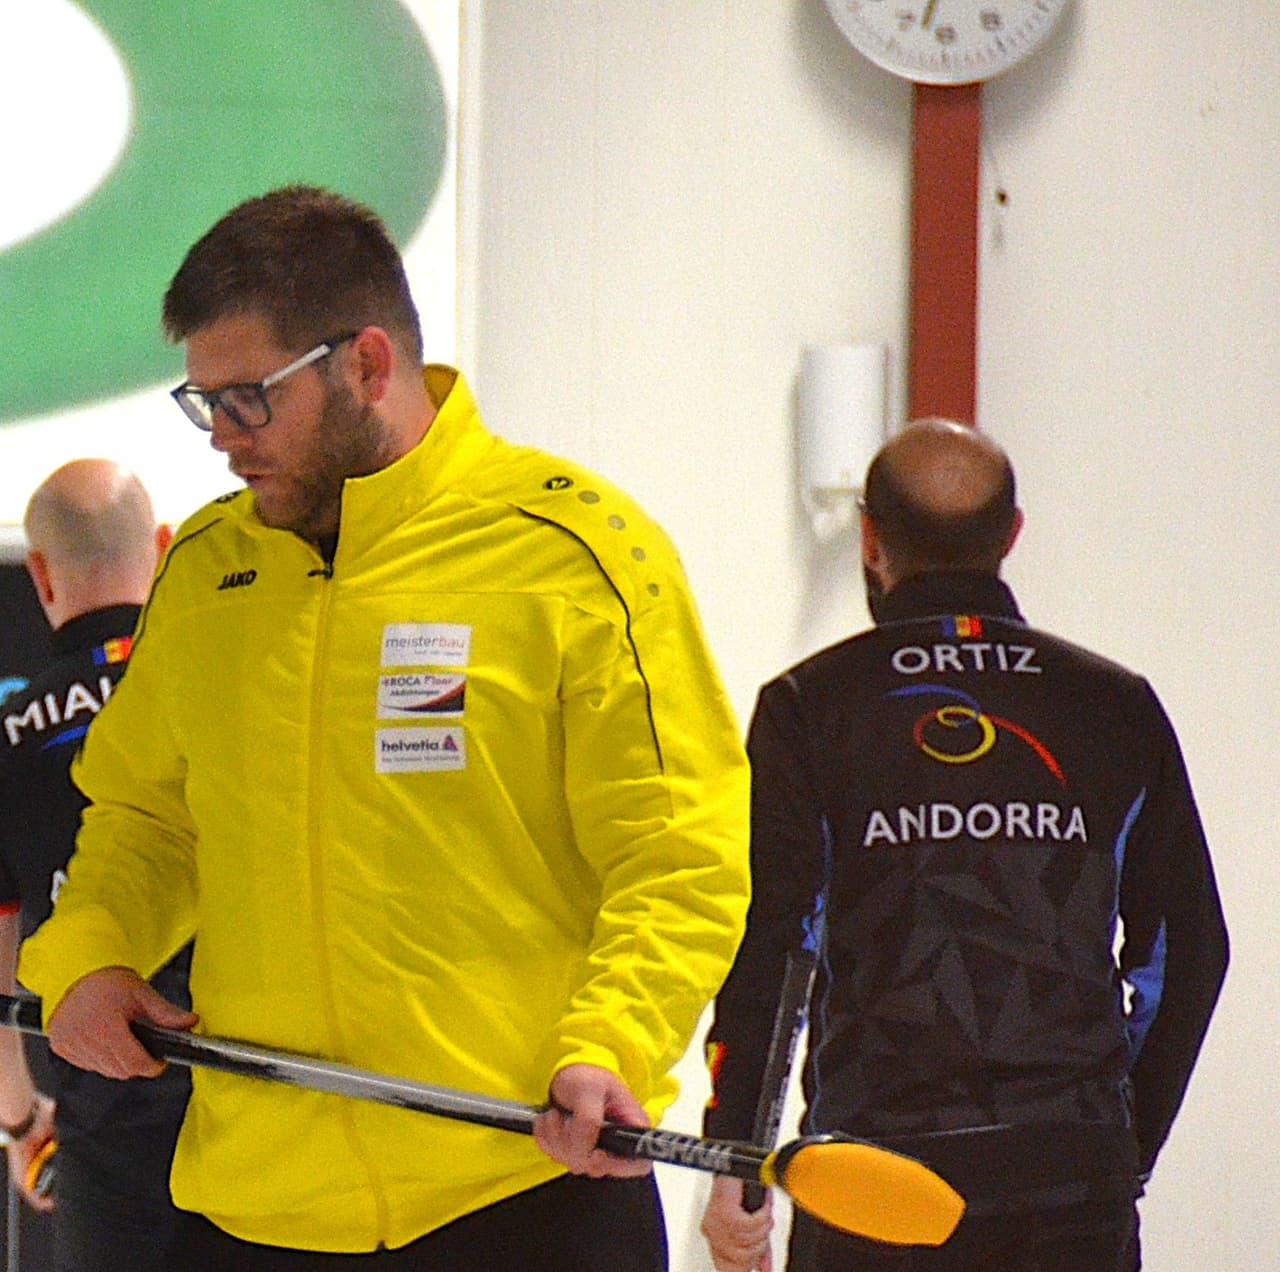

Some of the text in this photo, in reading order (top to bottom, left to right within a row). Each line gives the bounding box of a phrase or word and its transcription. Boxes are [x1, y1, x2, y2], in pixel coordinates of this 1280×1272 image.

[892, 643, 1042, 675] ORTIZ
[381, 740, 439, 752] helvetia
[864, 803, 1088, 847] ANDORRA
